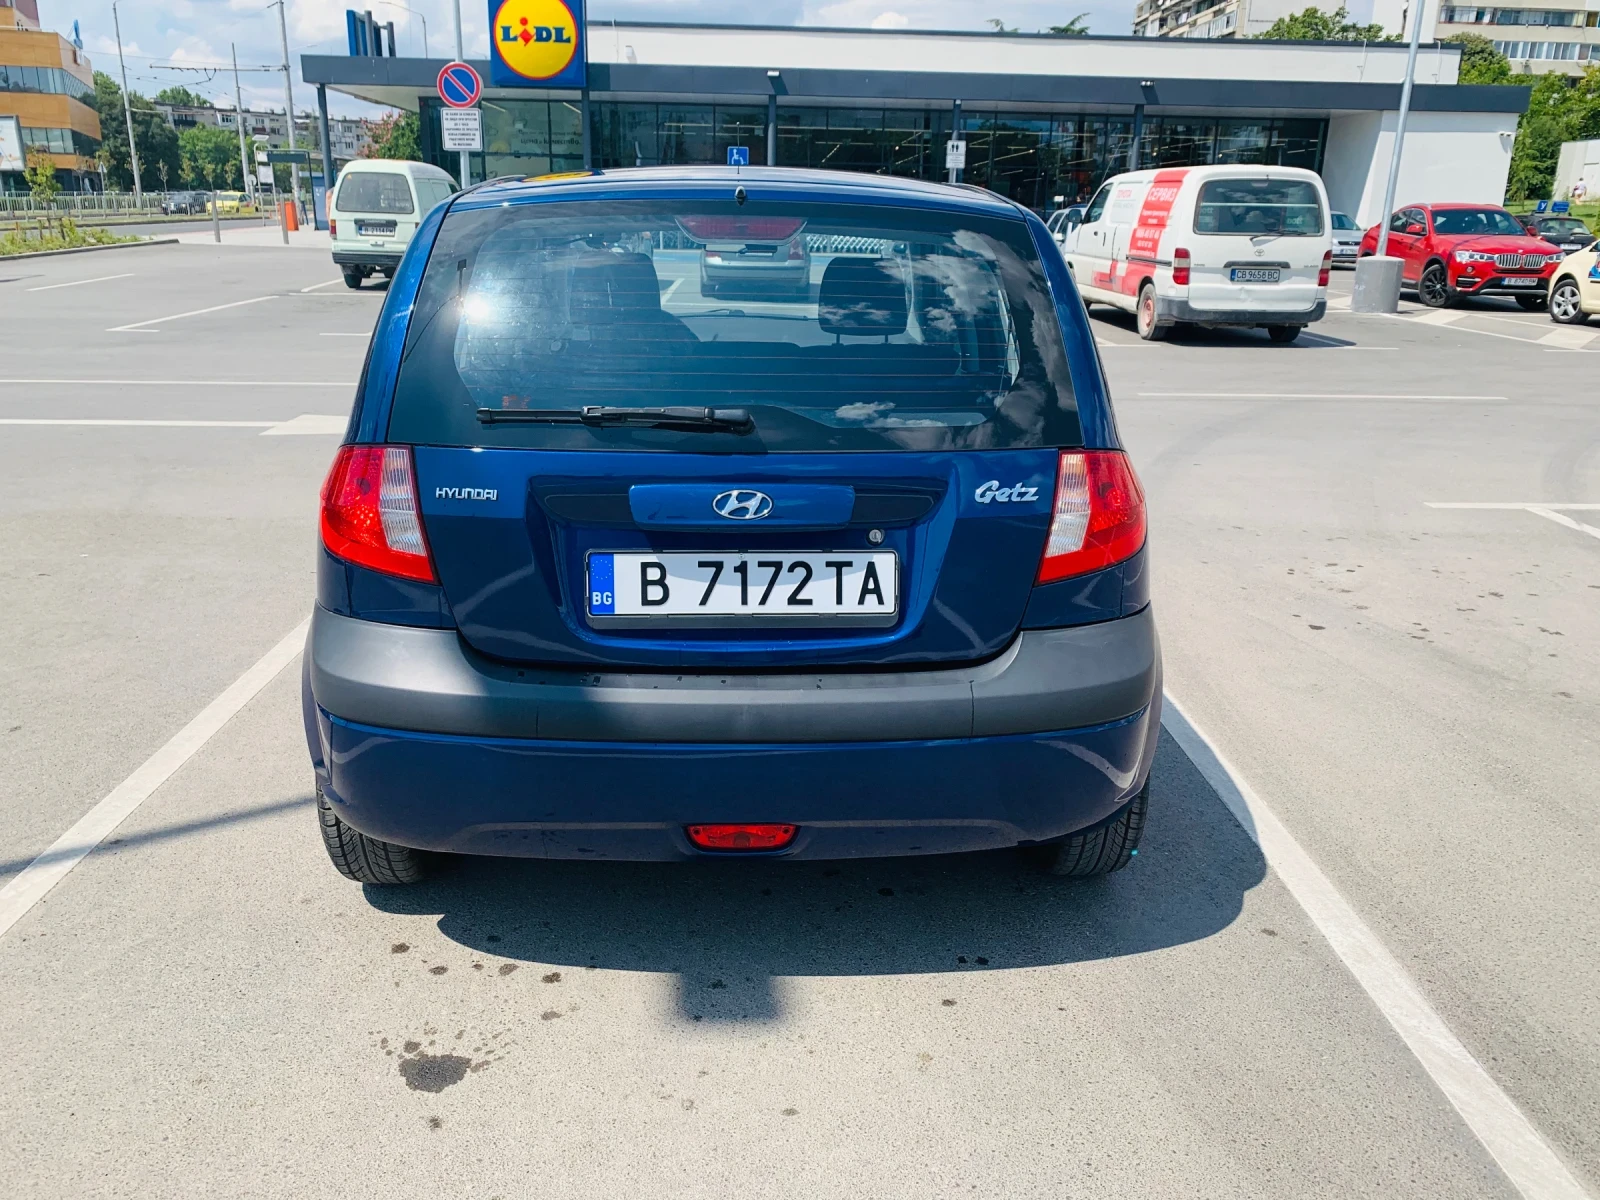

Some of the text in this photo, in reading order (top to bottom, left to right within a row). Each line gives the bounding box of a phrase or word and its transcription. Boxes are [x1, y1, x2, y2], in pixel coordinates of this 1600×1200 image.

[1148, 187, 1177, 202] СЕРВИЗ
[435, 487, 498, 500] HYUNDAI
[974, 480, 1039, 503] Getz
[640, 561, 670, 606] B
[592, 591, 612, 605] BG
